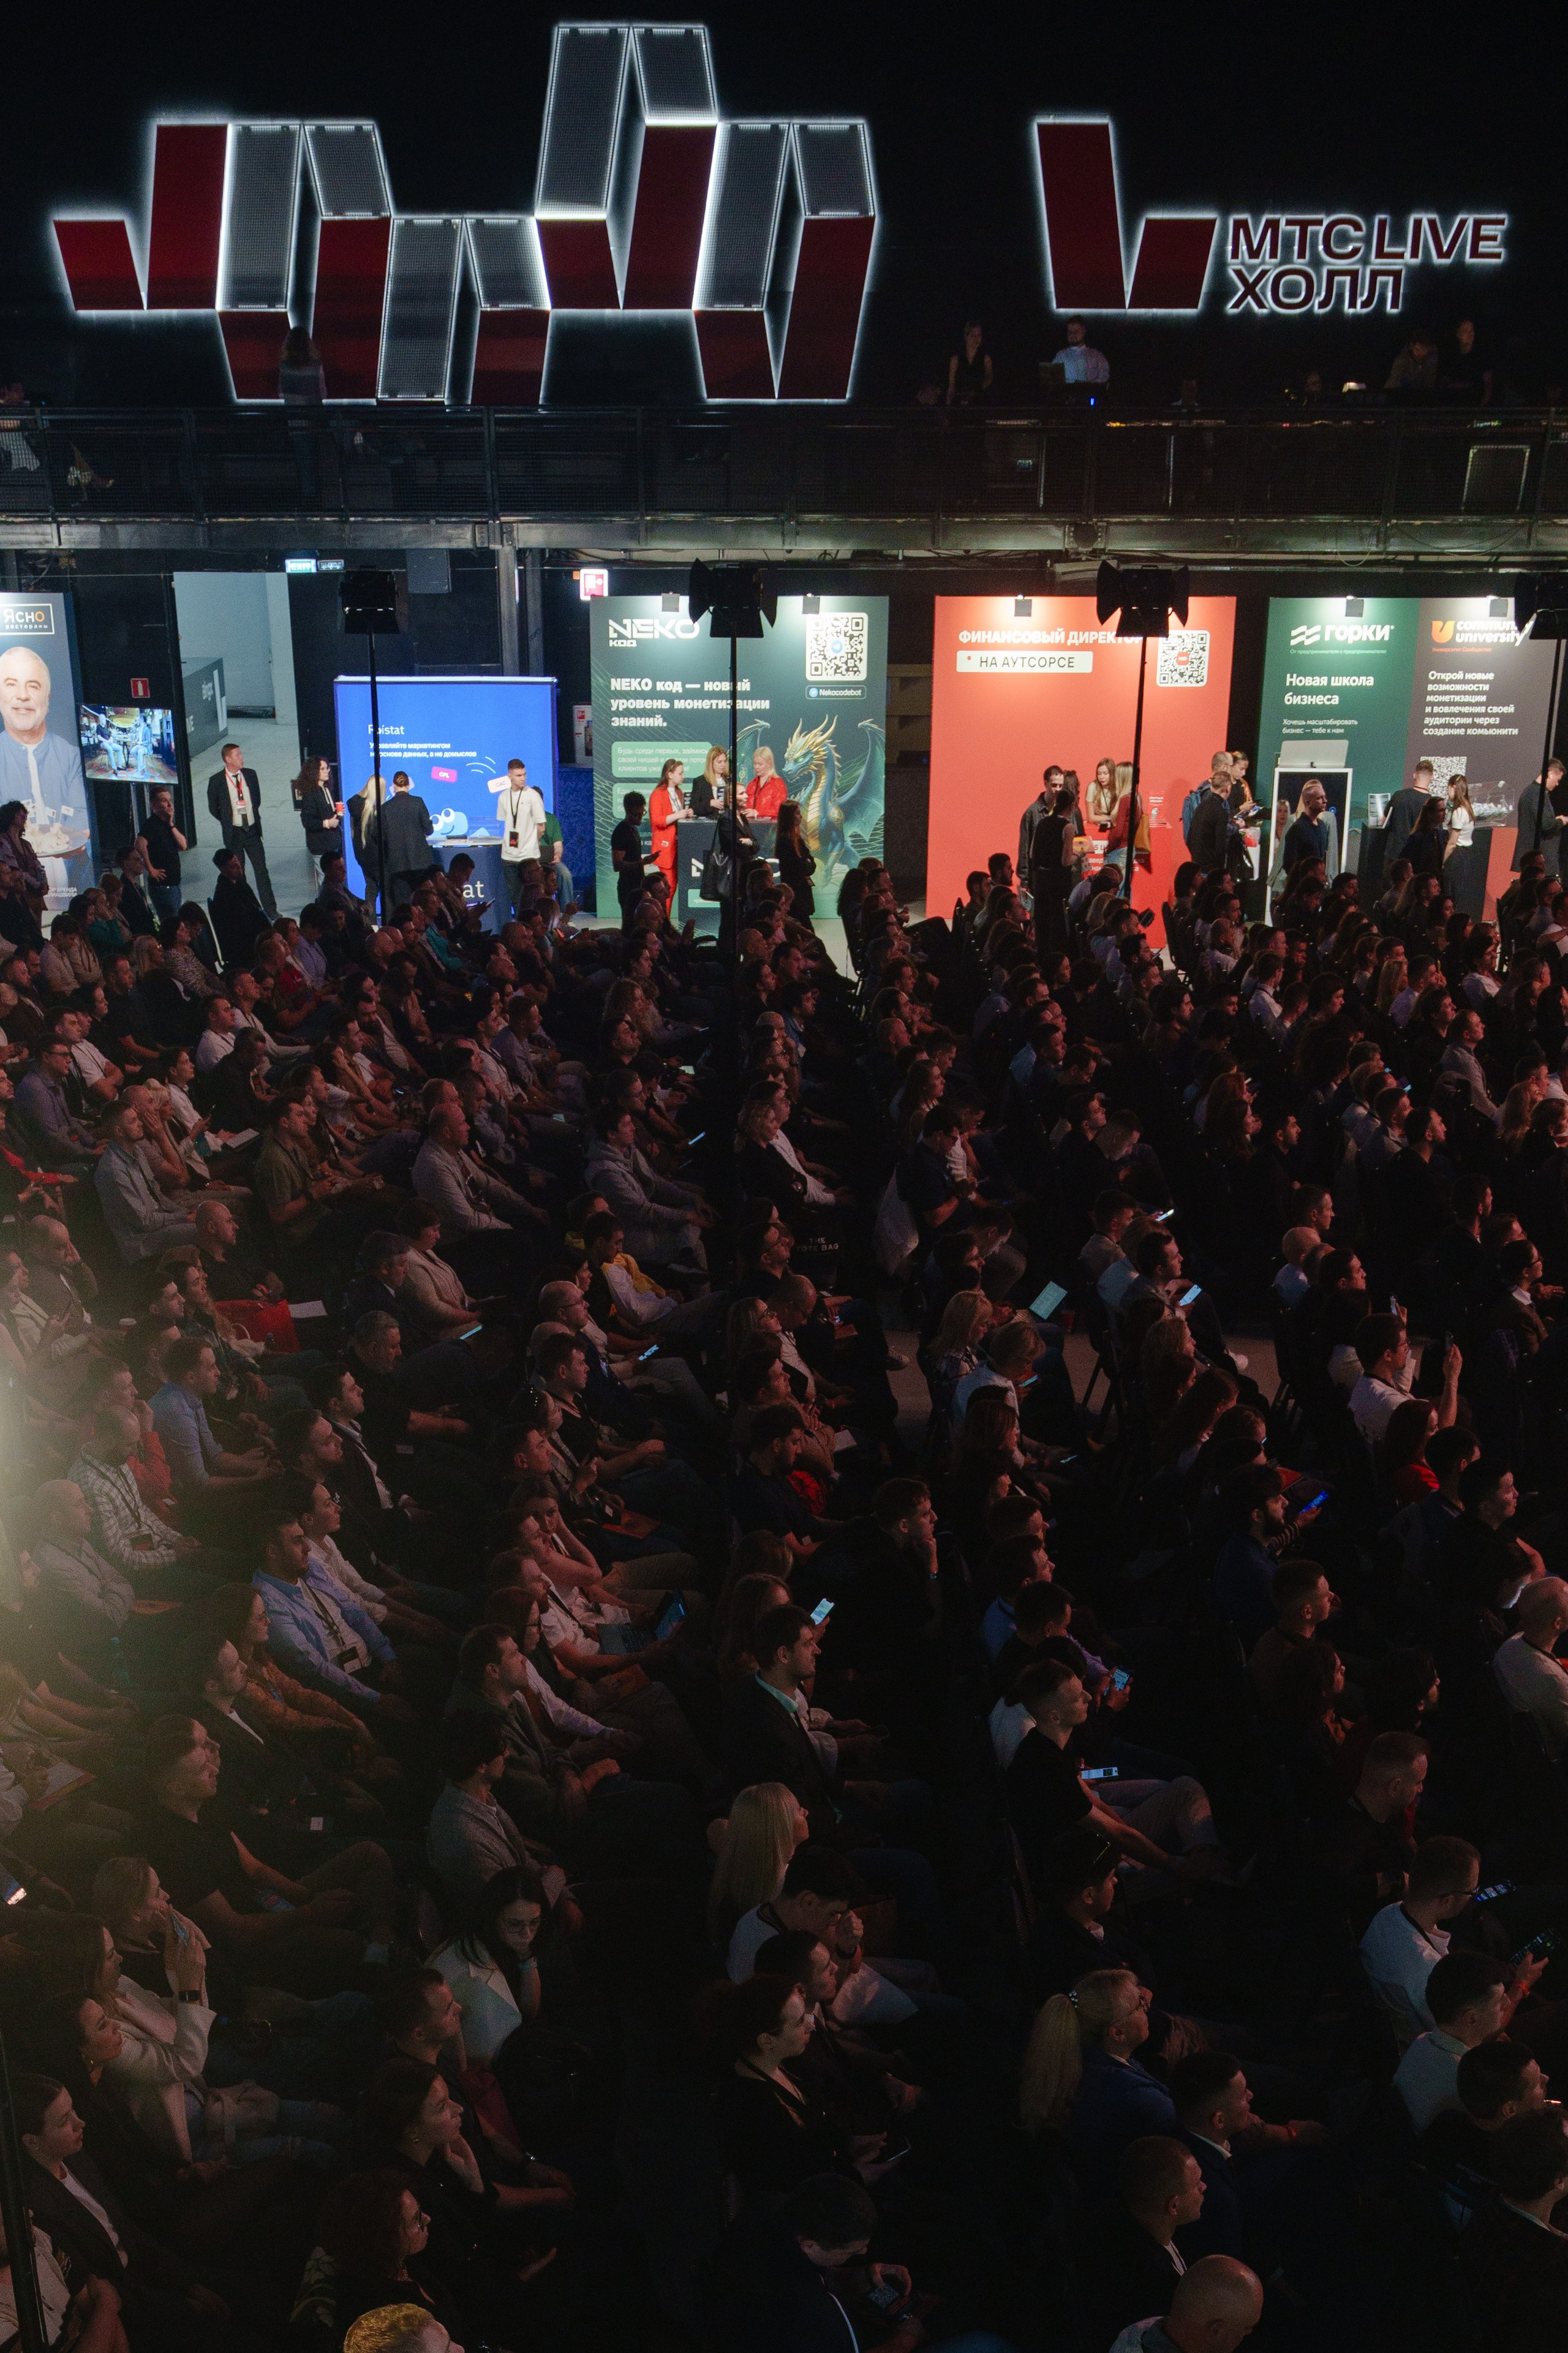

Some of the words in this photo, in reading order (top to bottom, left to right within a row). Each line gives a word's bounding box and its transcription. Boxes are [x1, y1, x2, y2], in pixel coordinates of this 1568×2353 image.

[1371, 213, 1508, 263] LIVE
[1226, 263, 1406, 314] ХОЛЛ
[608, 618, 700, 639] NEKO
[959, 628, 1065, 644] ФИНАНСОВЫЙ
[980, 656, 997, 668] НА
[1001, 656, 1074, 668] АУТСОРСЕ
[1286, 673, 1328, 686] Новая
[1331, 676, 1374, 686] школа
[1428, 671, 1463, 681] Открой
[611, 678, 652, 691] NEKO
[656, 681, 683, 692] код
[1284, 692, 1339, 704] бизнеса
[611, 699, 670, 711] уровень
[674, 699, 770, 711] монетизации
[1487, 704, 1515, 713] своей
[611, 714, 667, 727] знаний.
[617, 747, 633, 756] Будь
